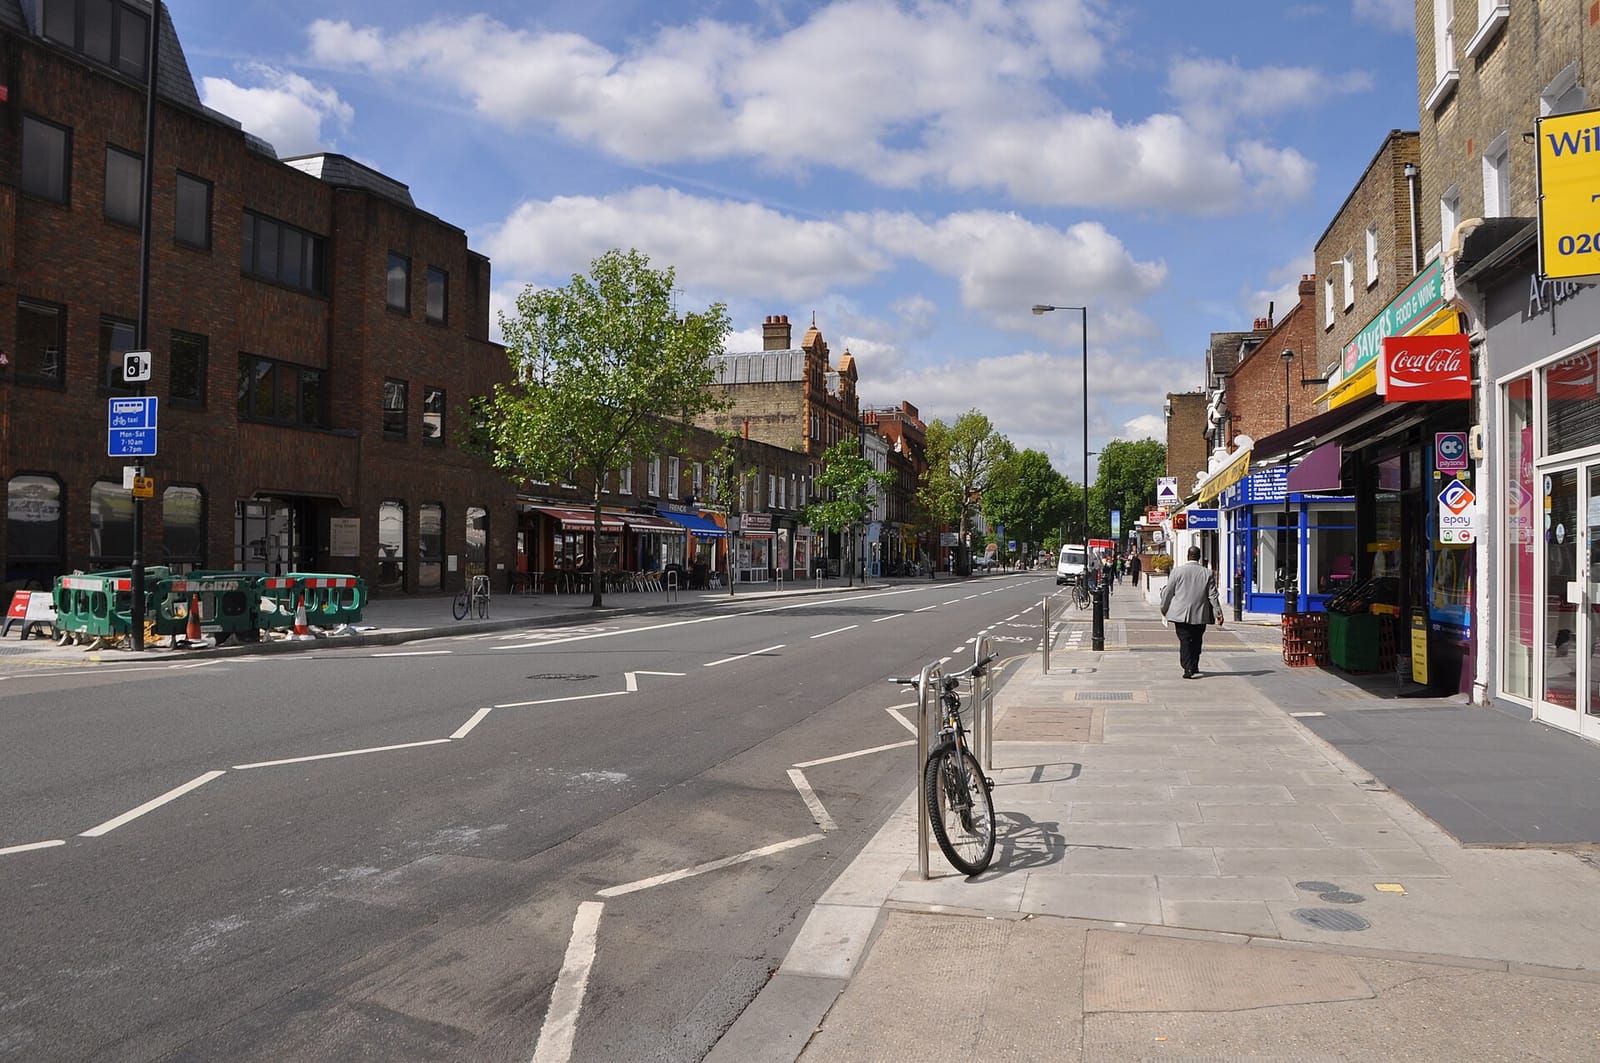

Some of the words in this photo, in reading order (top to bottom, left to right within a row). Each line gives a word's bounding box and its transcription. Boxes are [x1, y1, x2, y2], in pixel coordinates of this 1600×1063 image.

[1357, 309, 1392, 361] SAVERS
[1395, 301, 1412, 328] FOOD
[1411, 296, 1418, 314] &
[1417, 279, 1437, 308] WINE
[1390, 348, 1463, 374] Coca-Cola
[1443, 516, 1470, 526] epay
